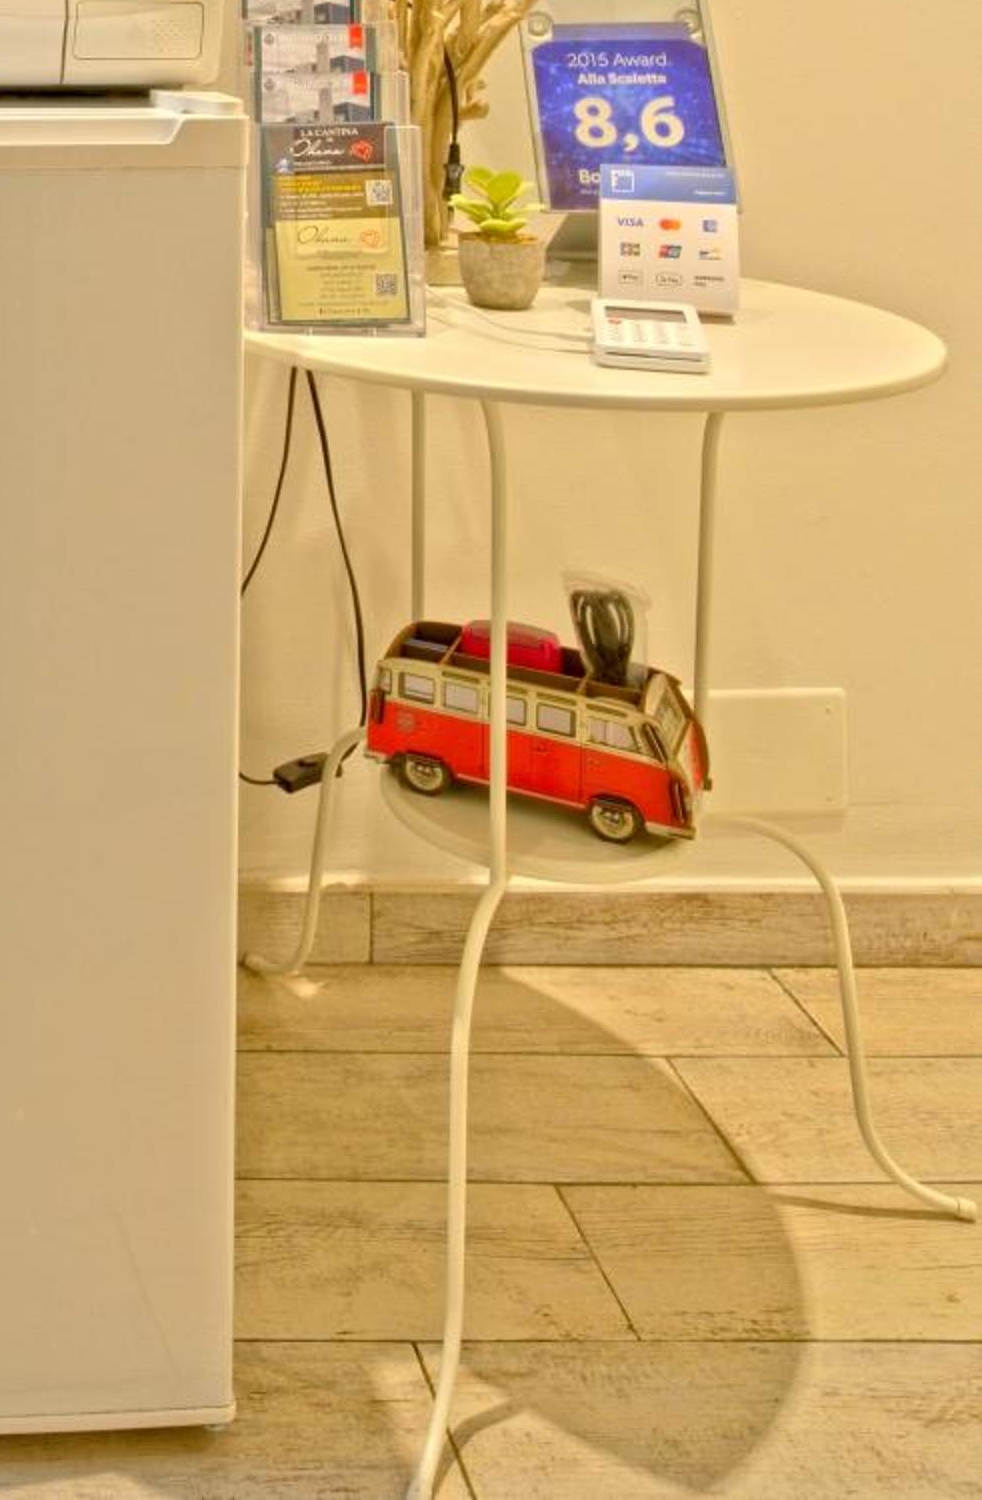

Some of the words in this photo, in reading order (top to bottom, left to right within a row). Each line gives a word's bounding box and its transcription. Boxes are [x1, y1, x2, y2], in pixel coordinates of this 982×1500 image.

[567, 52, 610, 68] 2015
[613, 51, 668, 67] Award
[577, 73, 606, 85] Alla
[573, 95, 686, 152] 8,6
[617, 217, 644, 228] VISA
